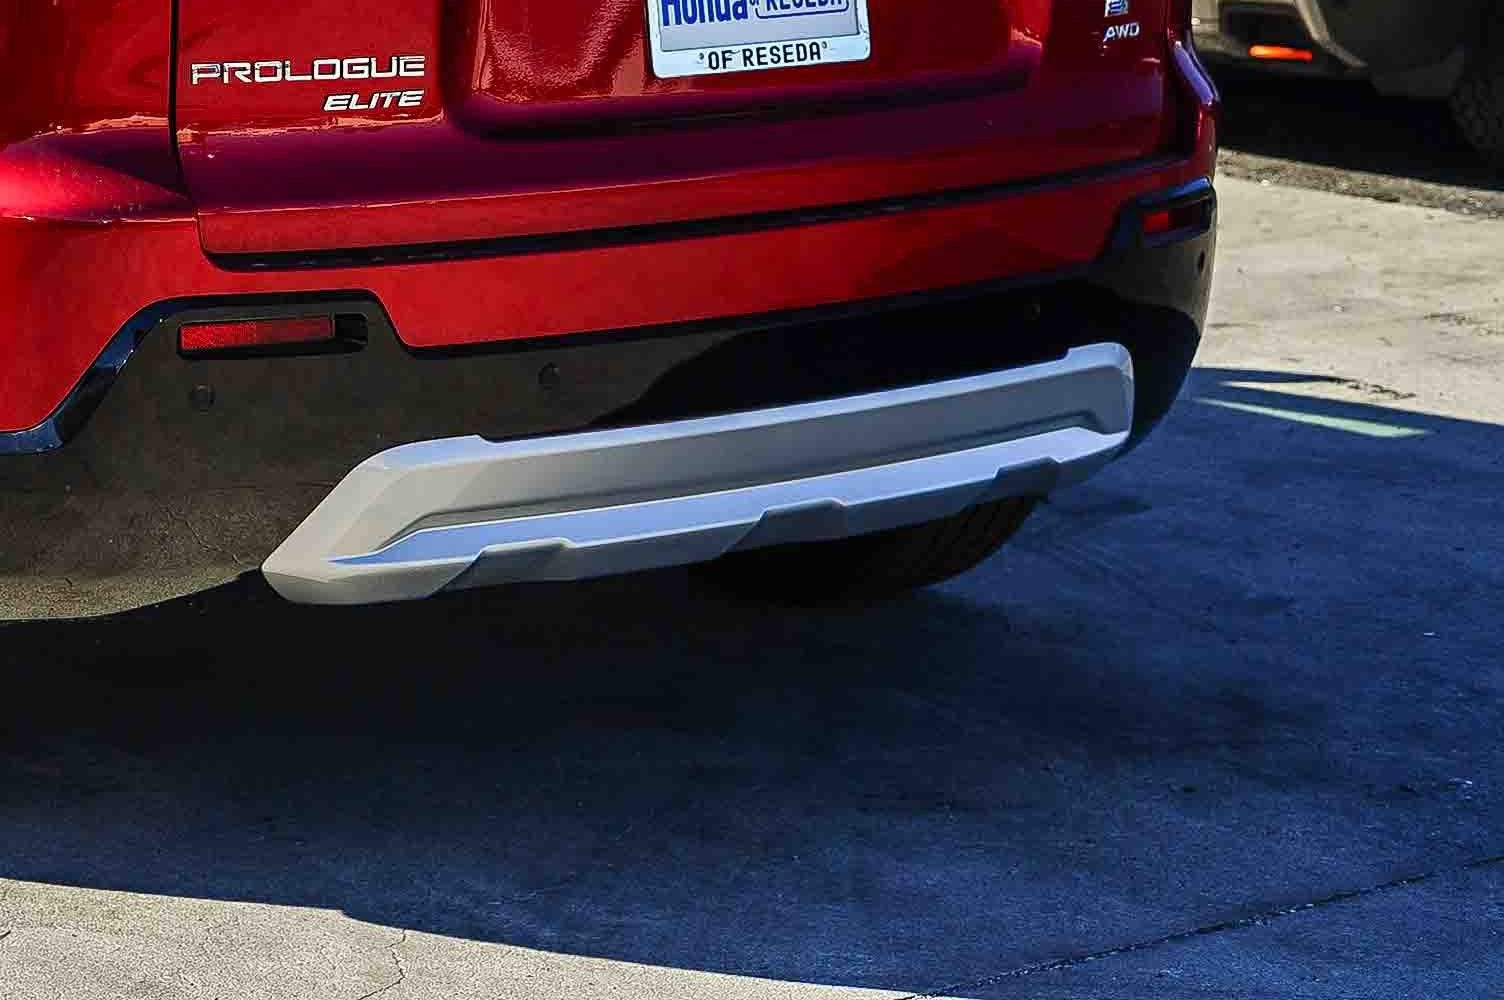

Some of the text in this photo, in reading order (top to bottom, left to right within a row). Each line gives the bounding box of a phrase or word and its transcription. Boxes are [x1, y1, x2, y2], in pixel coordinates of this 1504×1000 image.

[1102, 21, 1141, 43] AWD
[707, 42, 822, 70] OF RESEDA
[190, 55, 426, 86] PROLOGUE
[323, 90, 425, 112] ELITE
